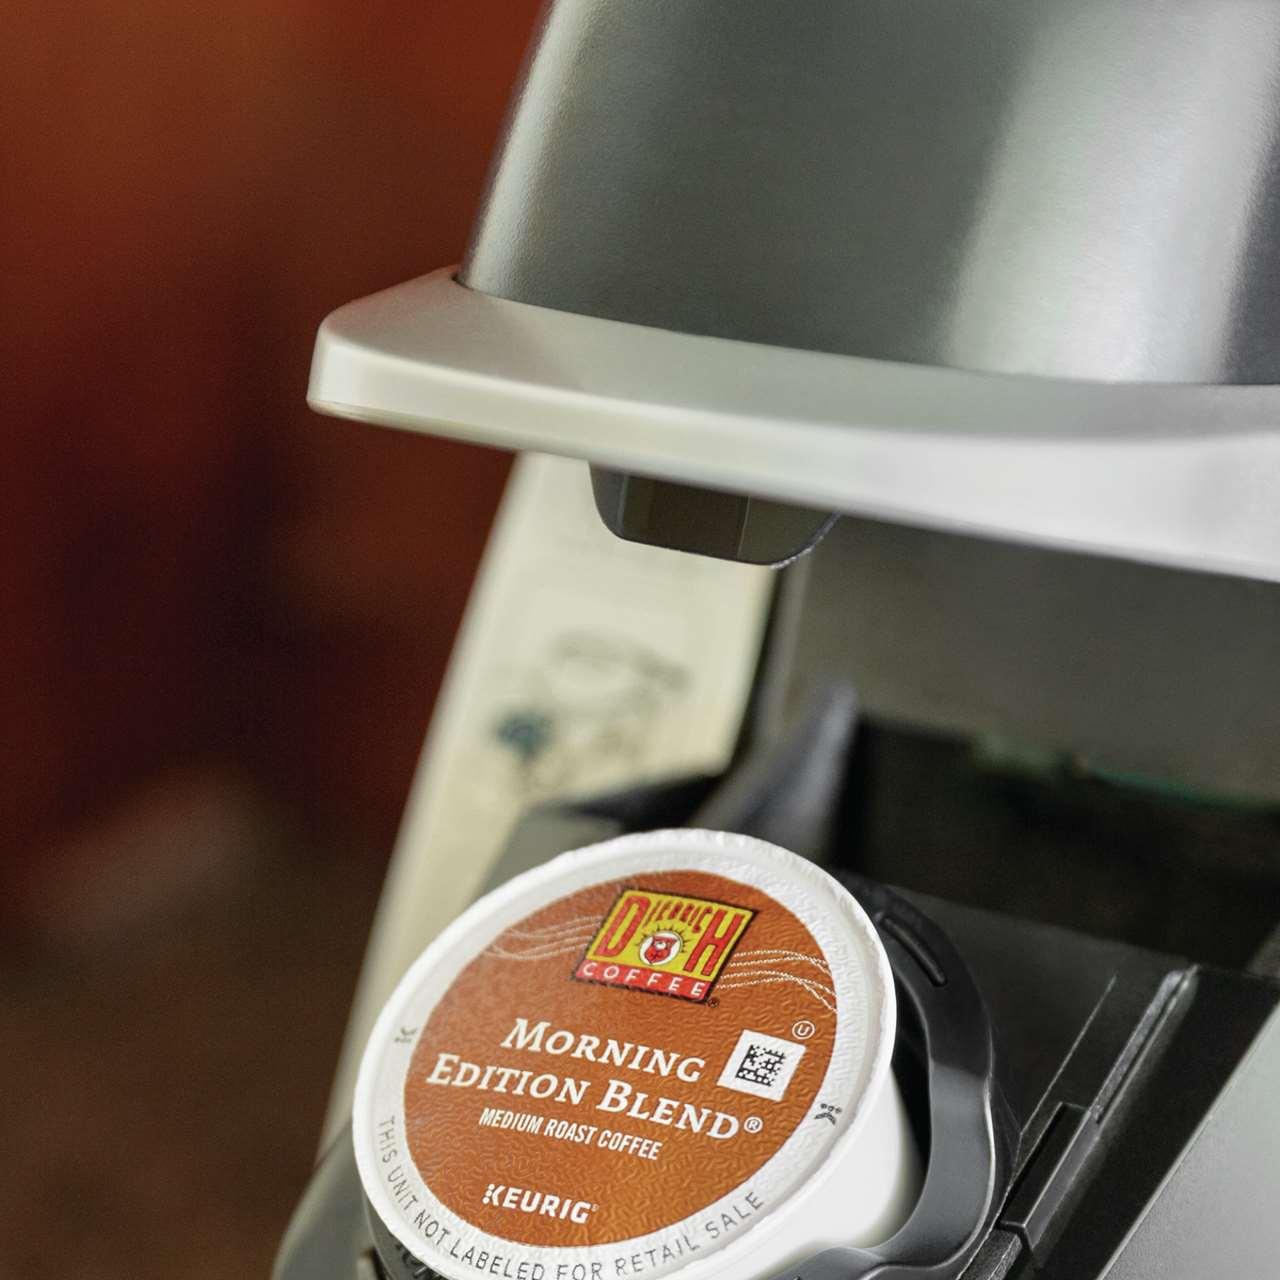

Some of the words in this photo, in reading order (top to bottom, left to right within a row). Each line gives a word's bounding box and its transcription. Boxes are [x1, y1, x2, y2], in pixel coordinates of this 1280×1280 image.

[583, 961, 706, 997] COFFEE
[500, 1018, 706, 1083] MORNING
[426, 1053, 591, 1105] EDITION
[378, 1115, 398, 1163] THIS
[479, 1107, 544, 1134] MEDIUM
[544, 1118, 598, 1146] ROAST
[598, 1130, 663, 1161] COFFEE
[387, 1165, 418, 1211] UNIT
[413, 1208, 450, 1246] NOT
[705, 1191, 765, 1239] SALE
[615, 1234, 701, 1277] RETAIL
